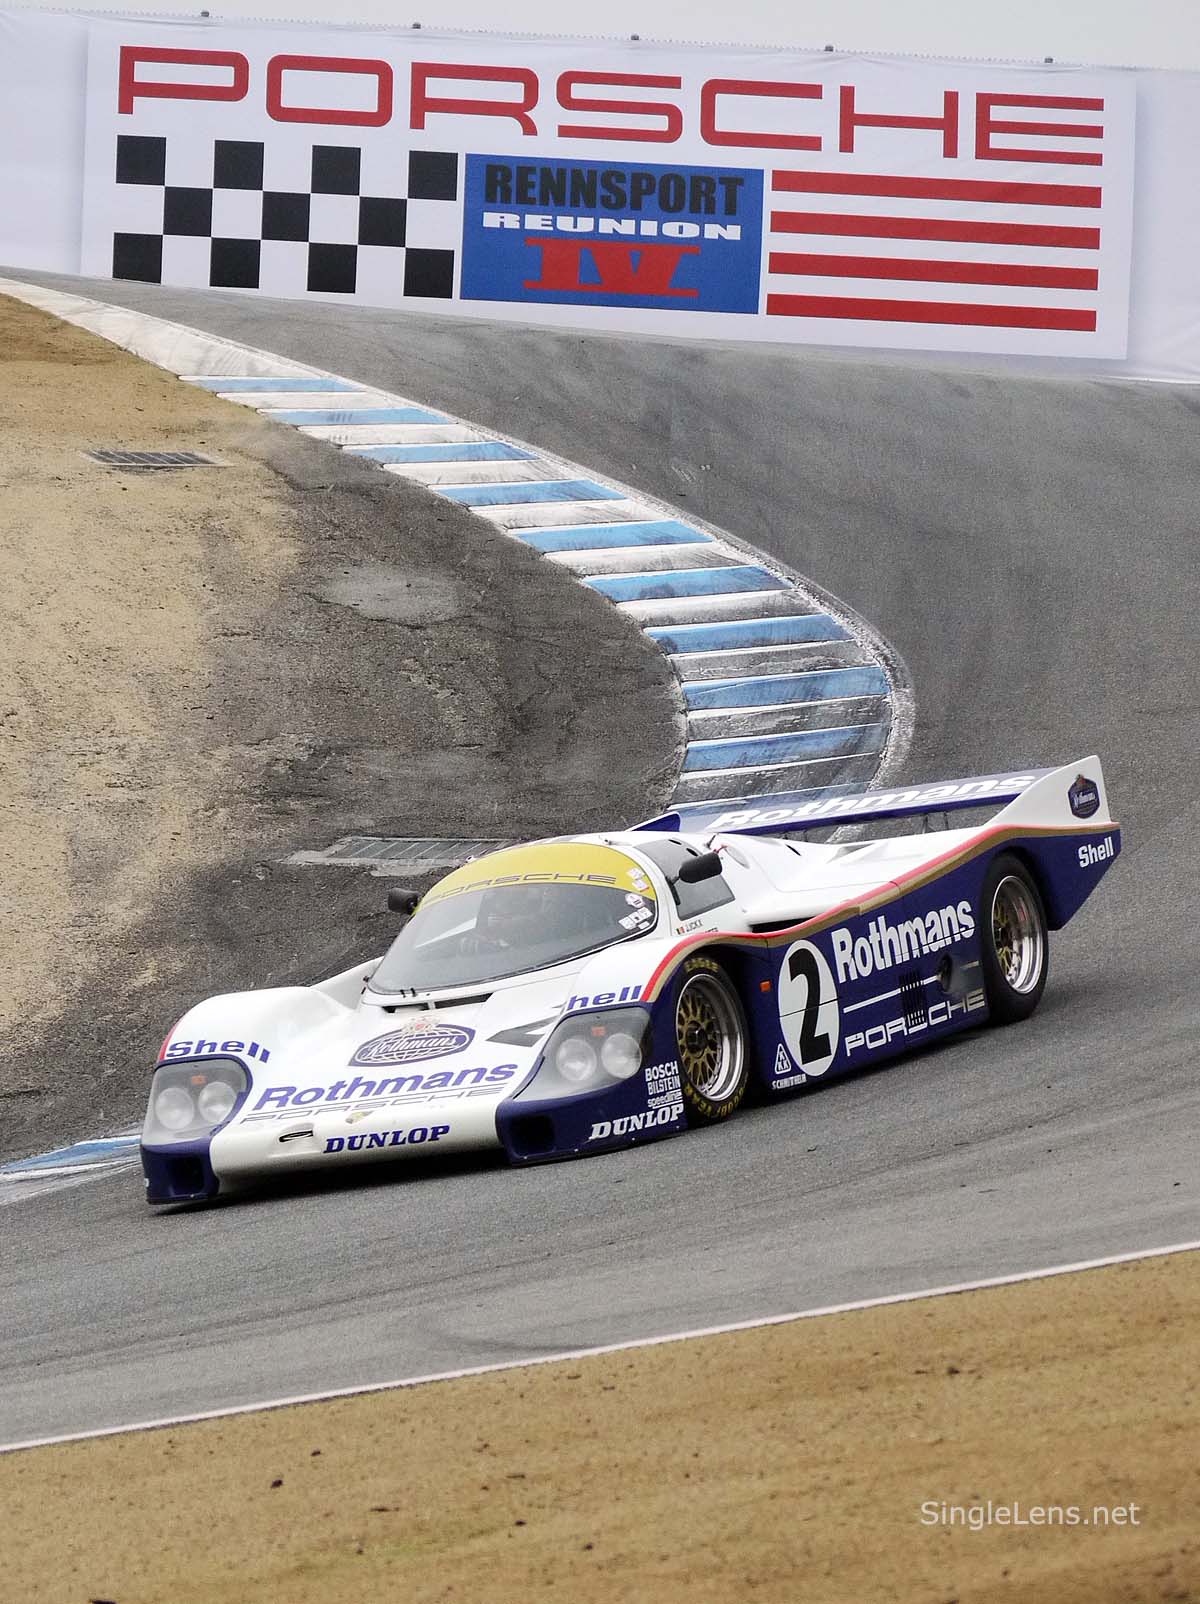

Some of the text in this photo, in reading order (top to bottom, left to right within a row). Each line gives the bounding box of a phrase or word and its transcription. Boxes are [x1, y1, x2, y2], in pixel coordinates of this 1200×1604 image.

[118, 45, 1104, 167] PORSCHE
[484, 164, 745, 216] RENNSPORT
[483, 211, 741, 240] REUNION
[524, 237, 700, 297] IV
[704, 775, 1034, 829] Rothmans
[1078, 837, 1114, 867] Shell
[831, 900, 976, 983] Rothmans
[566, 985, 643, 1010] hell
[788, 947, 831, 1065] 2
[844, 987, 985, 1056] PORSCHE
[166, 1040, 271, 1063] Shell
[362, 1035, 457, 1059] Rothmans
[253, 1063, 518, 1111] Rothmans
[645, 1060, 679, 1082] BOSCH
[647, 1075, 681, 1095] BILSTEIN
[240, 1085, 504, 1124] PORSCHE
[589, 1103, 684, 1141] DUNLOP
[323, 1125, 450, 1153] DUNLOP
